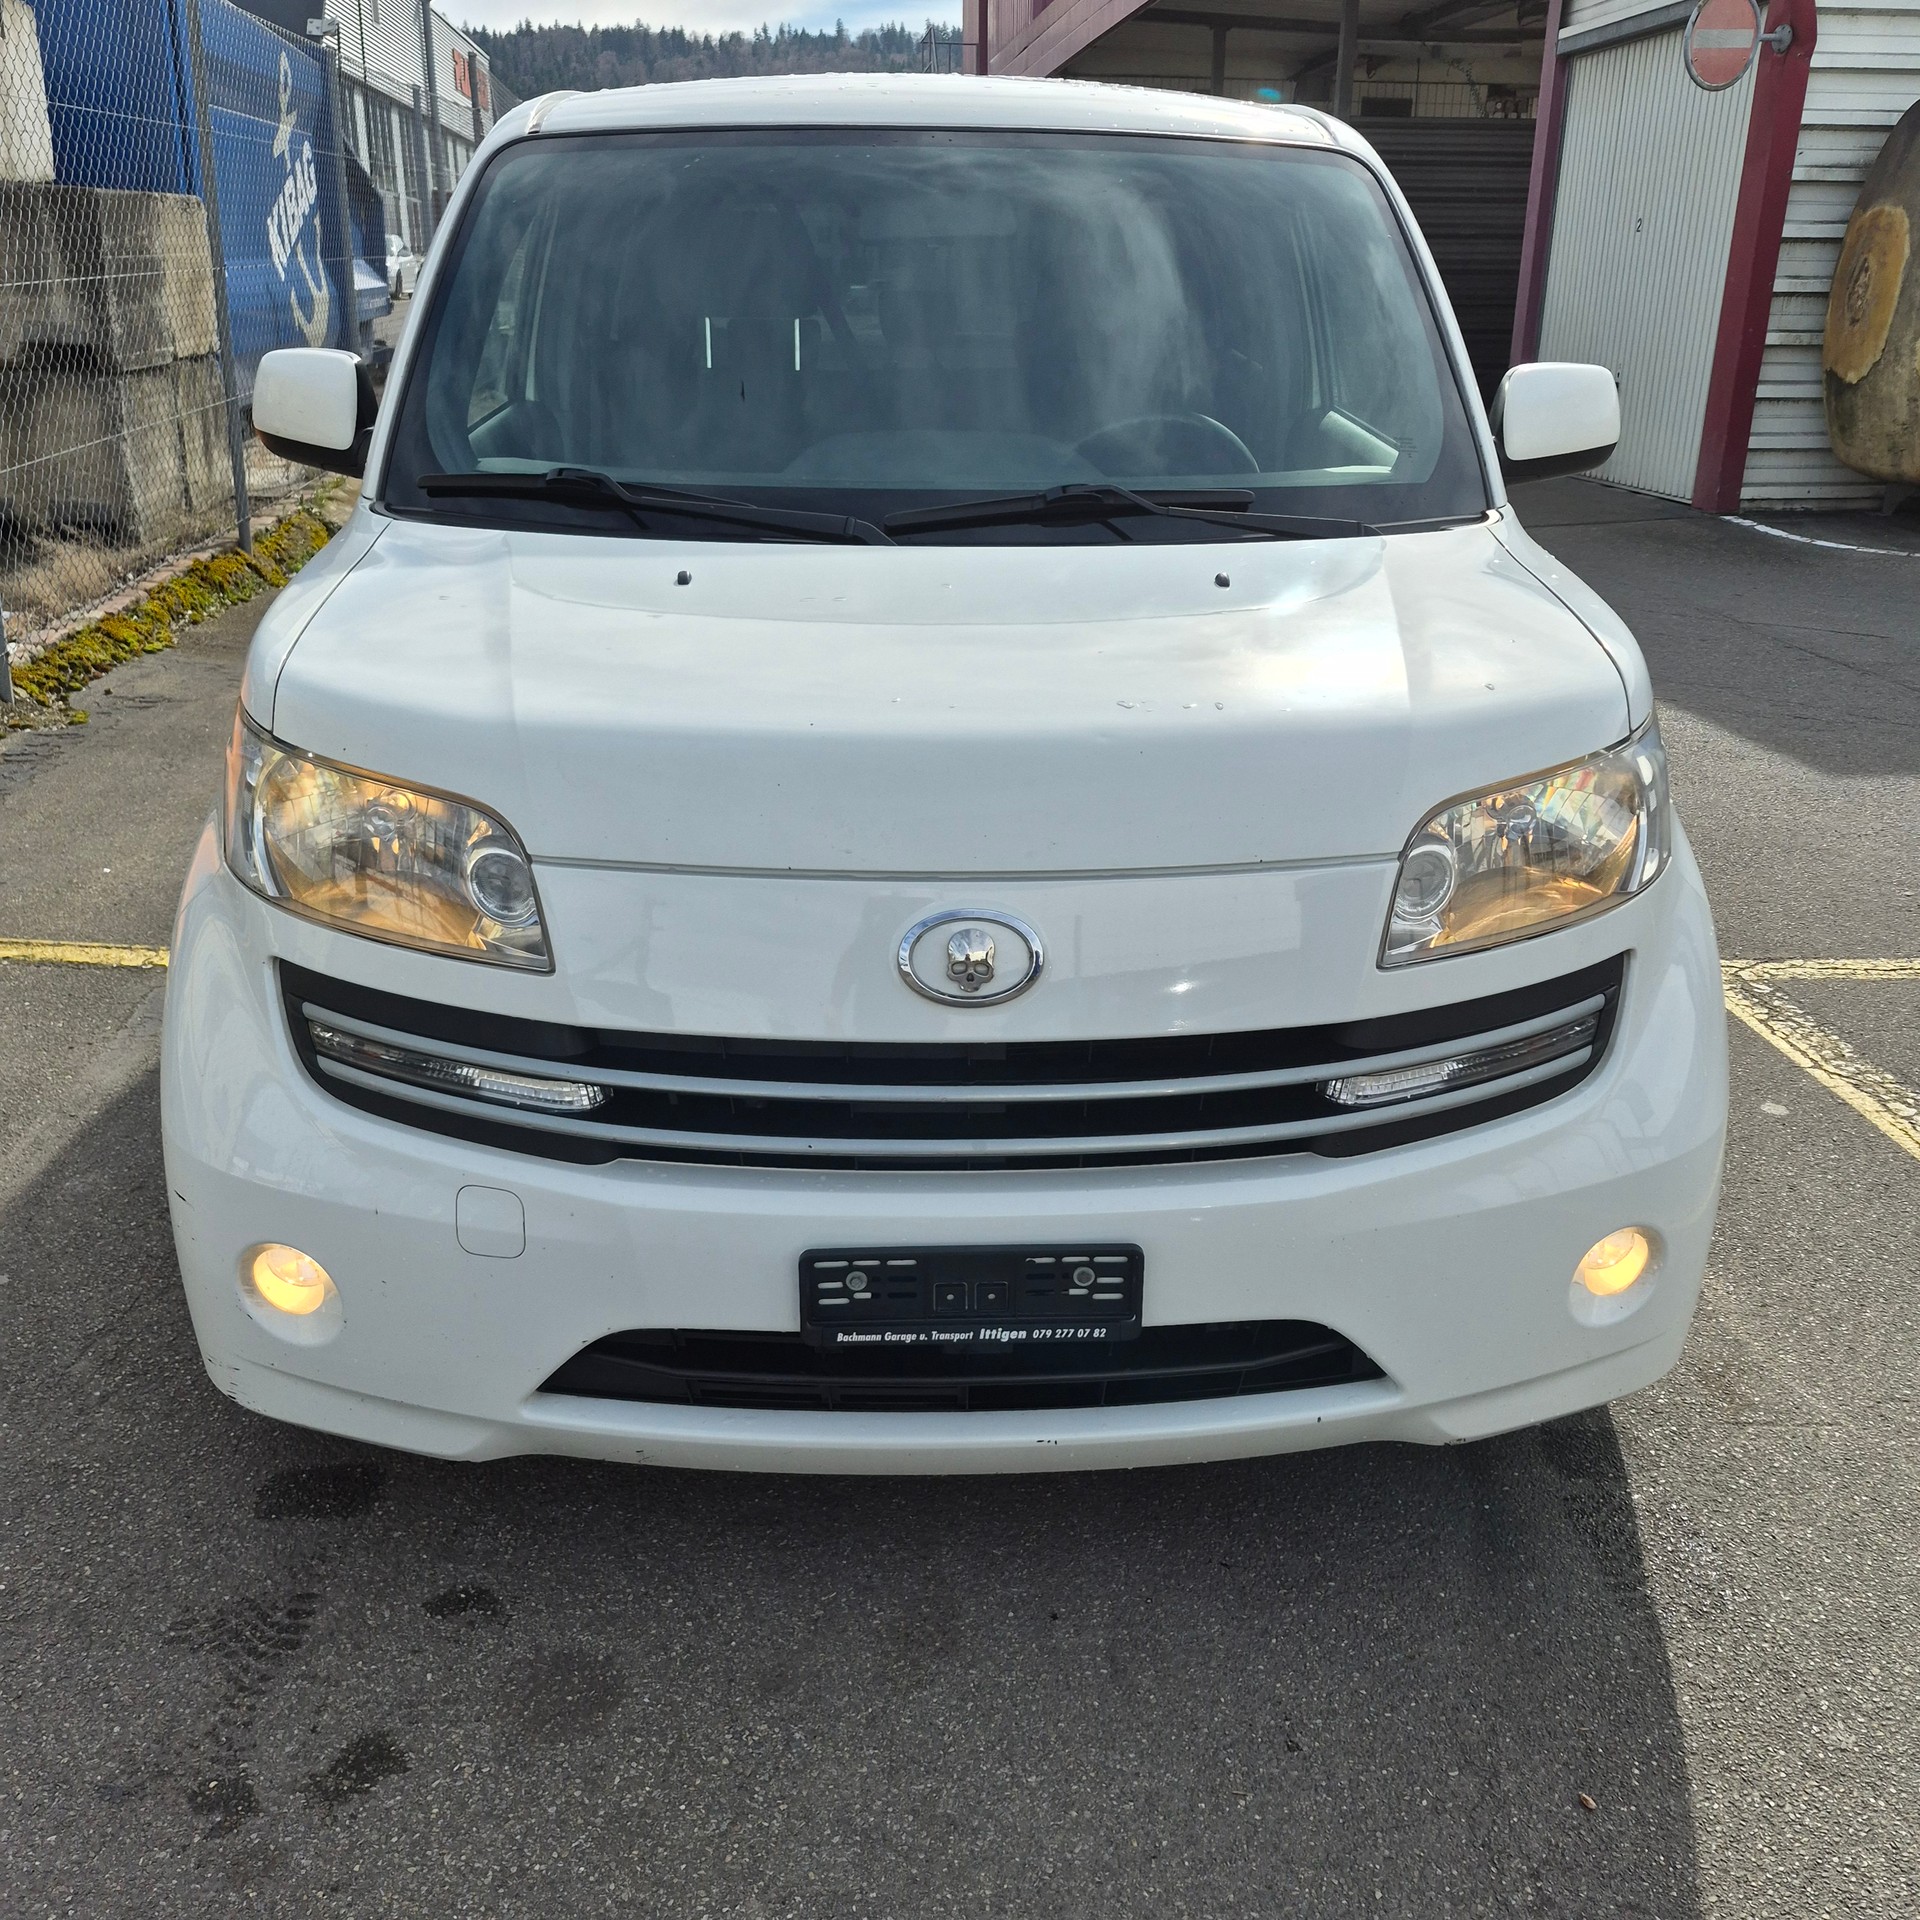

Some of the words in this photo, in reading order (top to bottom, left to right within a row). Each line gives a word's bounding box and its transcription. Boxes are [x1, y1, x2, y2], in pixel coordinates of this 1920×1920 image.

[267, 140, 318, 282] KIBAG
[1636, 217, 1642, 232] 2
[837, 1332, 882, 1342] Bachmann
[884, 1331, 917, 1343] Garage
[931, 1330, 974, 1342] Transport
[979, 1328, 1027, 1342] Ittigen
[1032, 1329, 1053, 1339] 079
[1055, 1328, 1075, 1339] 277
[1077, 1328, 1091, 1338] 07
[1093, 1328, 1107, 1338] 82
